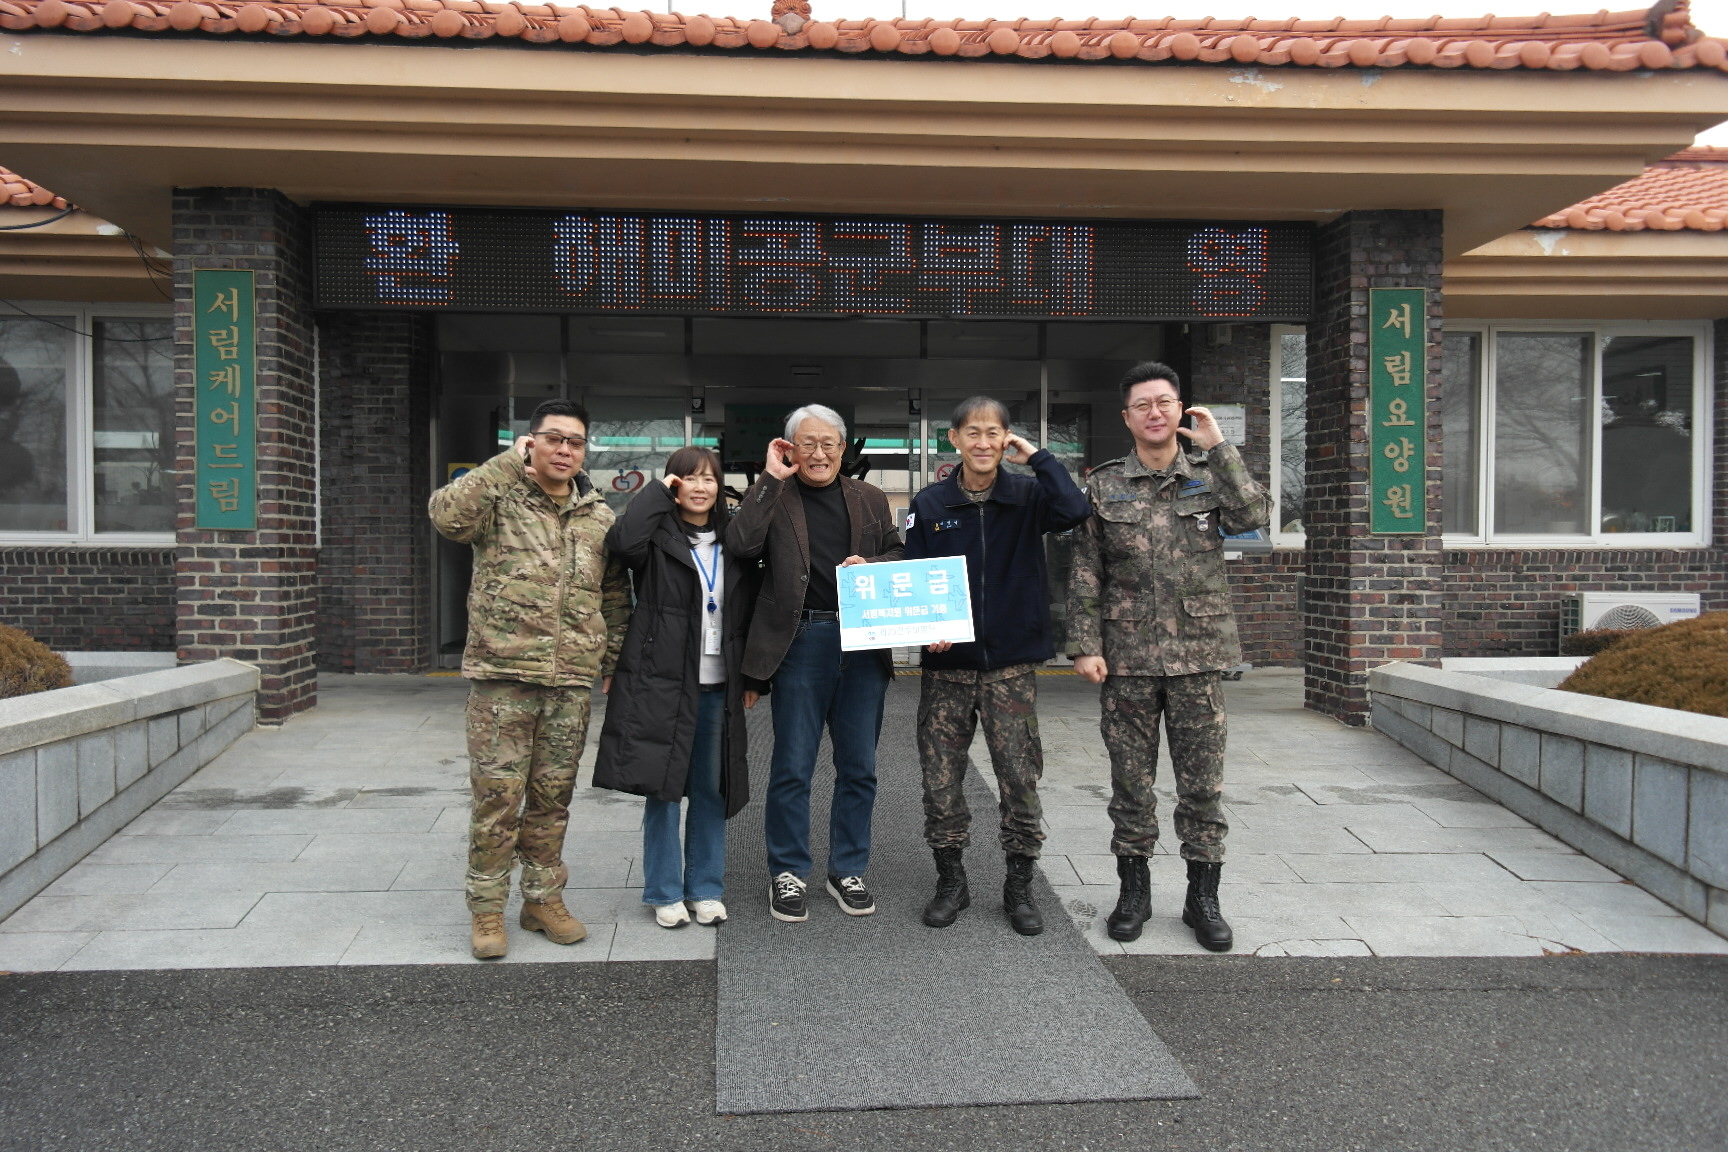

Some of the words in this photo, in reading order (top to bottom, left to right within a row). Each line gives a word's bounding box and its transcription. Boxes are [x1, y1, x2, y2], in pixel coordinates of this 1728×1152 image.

[365, 210, 459, 306] 환
[552, 214, 1094, 316] 해미공군부대
[1186, 227, 1268, 317] 영
[207, 287, 244, 513] 서림케어드림
[1382, 303, 1416, 519] 서림요양원
[904, 605, 929, 617] 위문금
